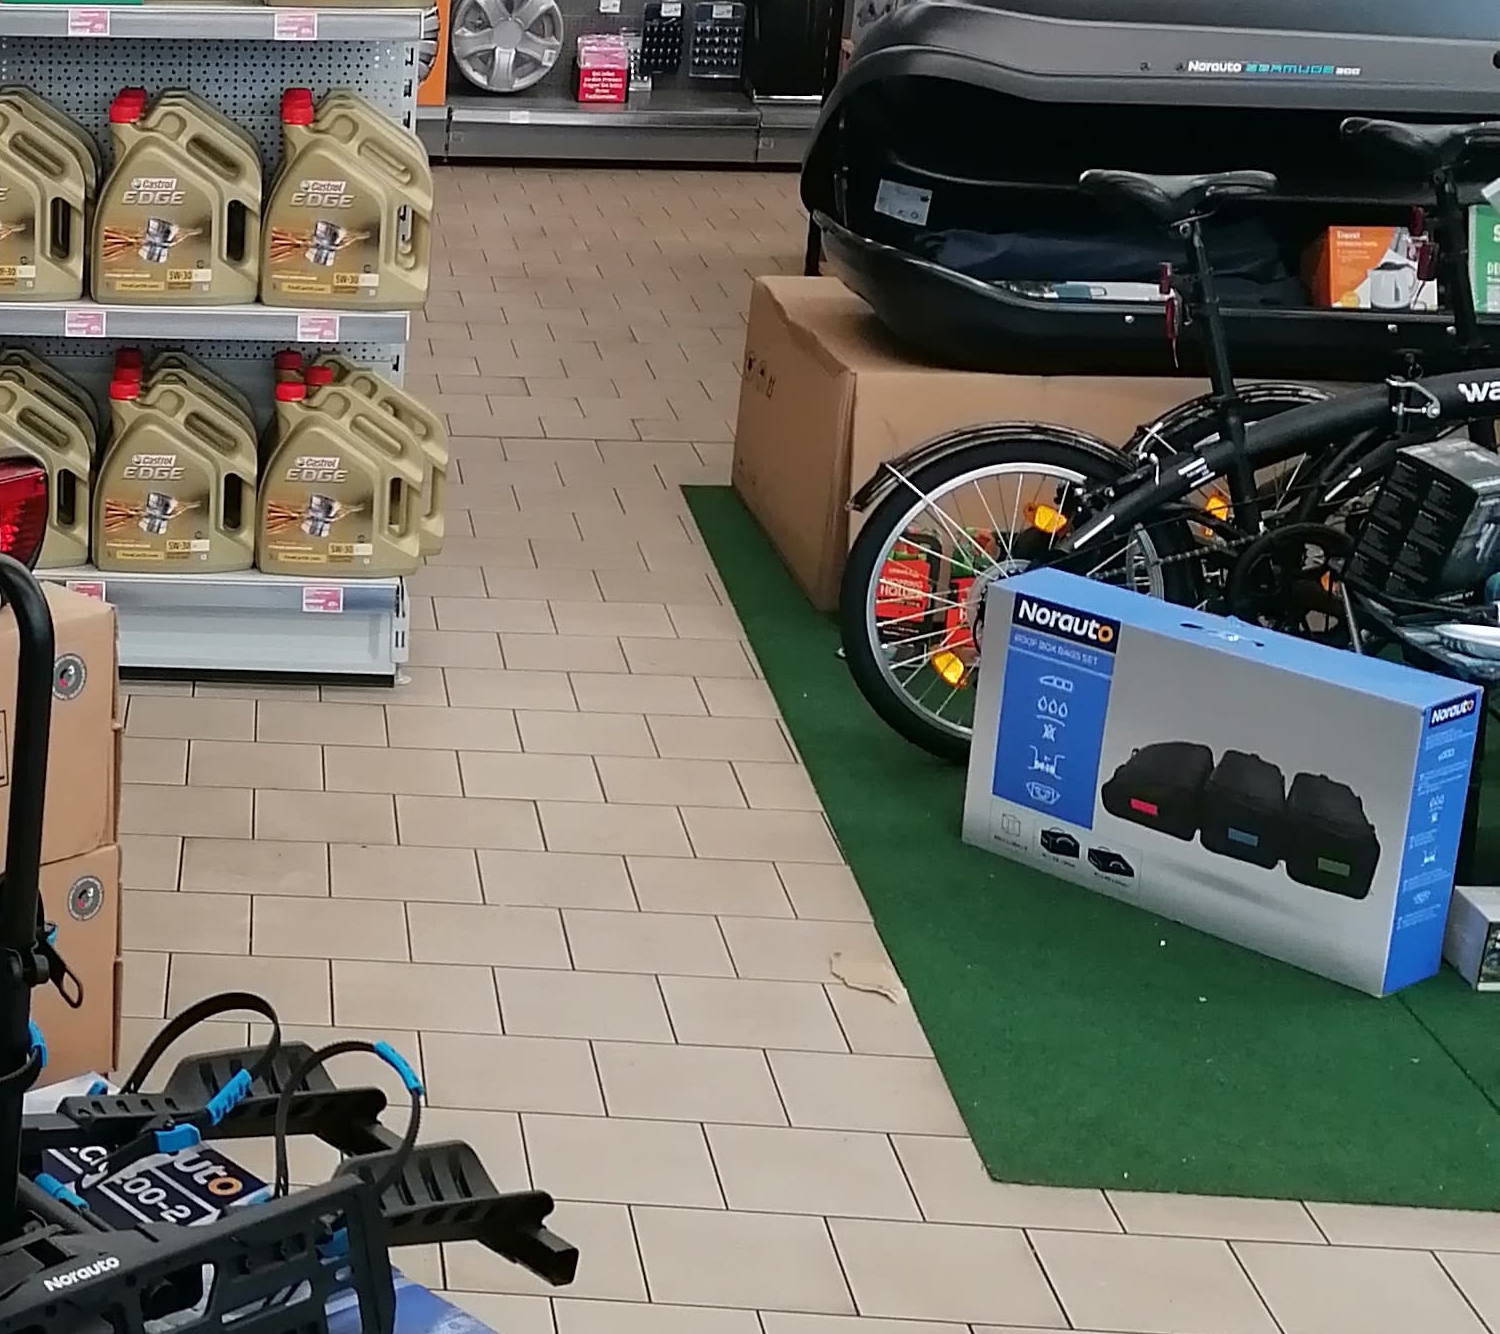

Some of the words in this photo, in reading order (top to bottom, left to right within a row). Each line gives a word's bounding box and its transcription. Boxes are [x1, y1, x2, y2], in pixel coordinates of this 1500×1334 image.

[1188, 60, 1241, 72] Norauto
[143, 179, 173, 191] Castrol
[311, 181, 343, 193] Castrol
[122, 191, 185, 205] EDGE
[291, 193, 354, 208] EDGE
[169, 271, 192, 281] 5W-30
[142, 455, 173, 467] Castrol
[306, 457, 338, 468] Castrol
[123, 467, 185, 480] EDGE
[285, 469, 348, 483] EDGE
[1019, 599, 1113, 643] Norauto
[1431, 699, 1475, 724] Norauto
[43, 1256, 120, 1292] Norauto
